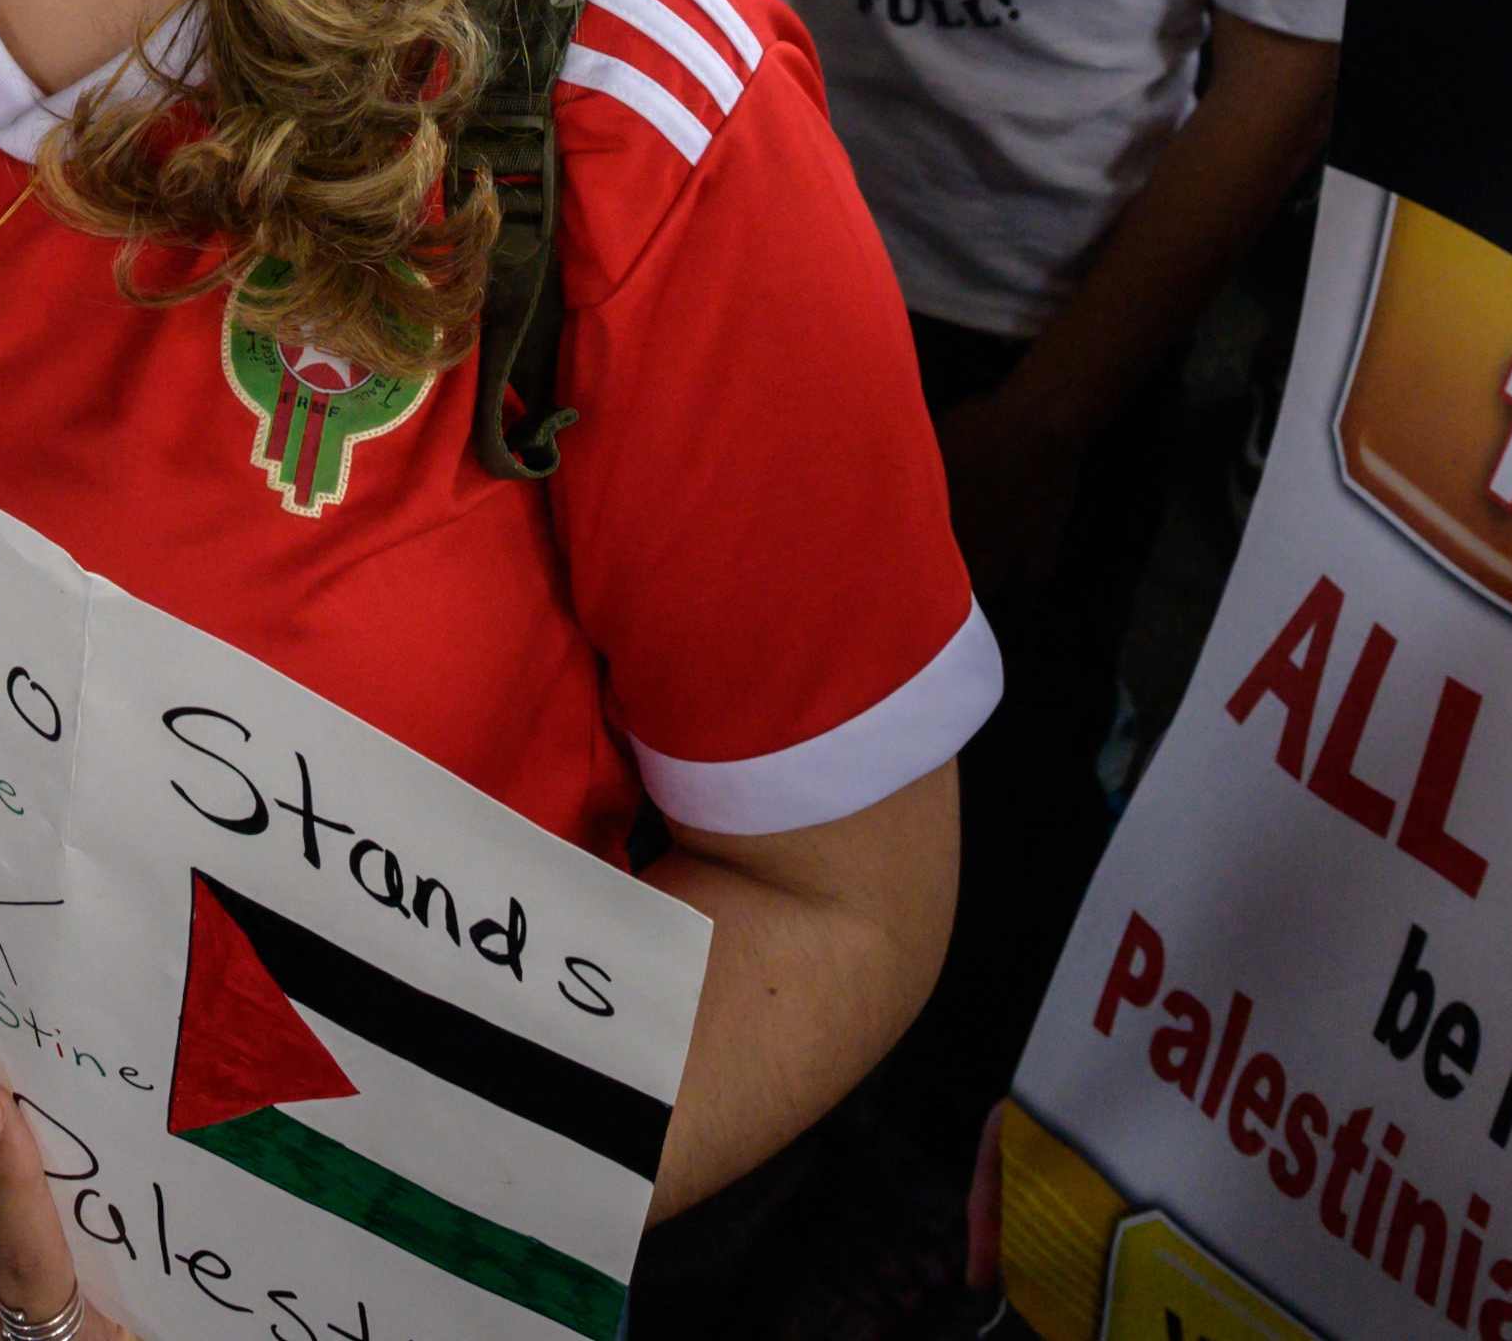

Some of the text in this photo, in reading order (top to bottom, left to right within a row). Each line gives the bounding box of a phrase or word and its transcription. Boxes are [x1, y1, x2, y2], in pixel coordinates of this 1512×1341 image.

[161, 704, 617, 1018] Stands
[1222, 572, 1490, 902] ALL
[1372, 921, 1483, 1103] be
